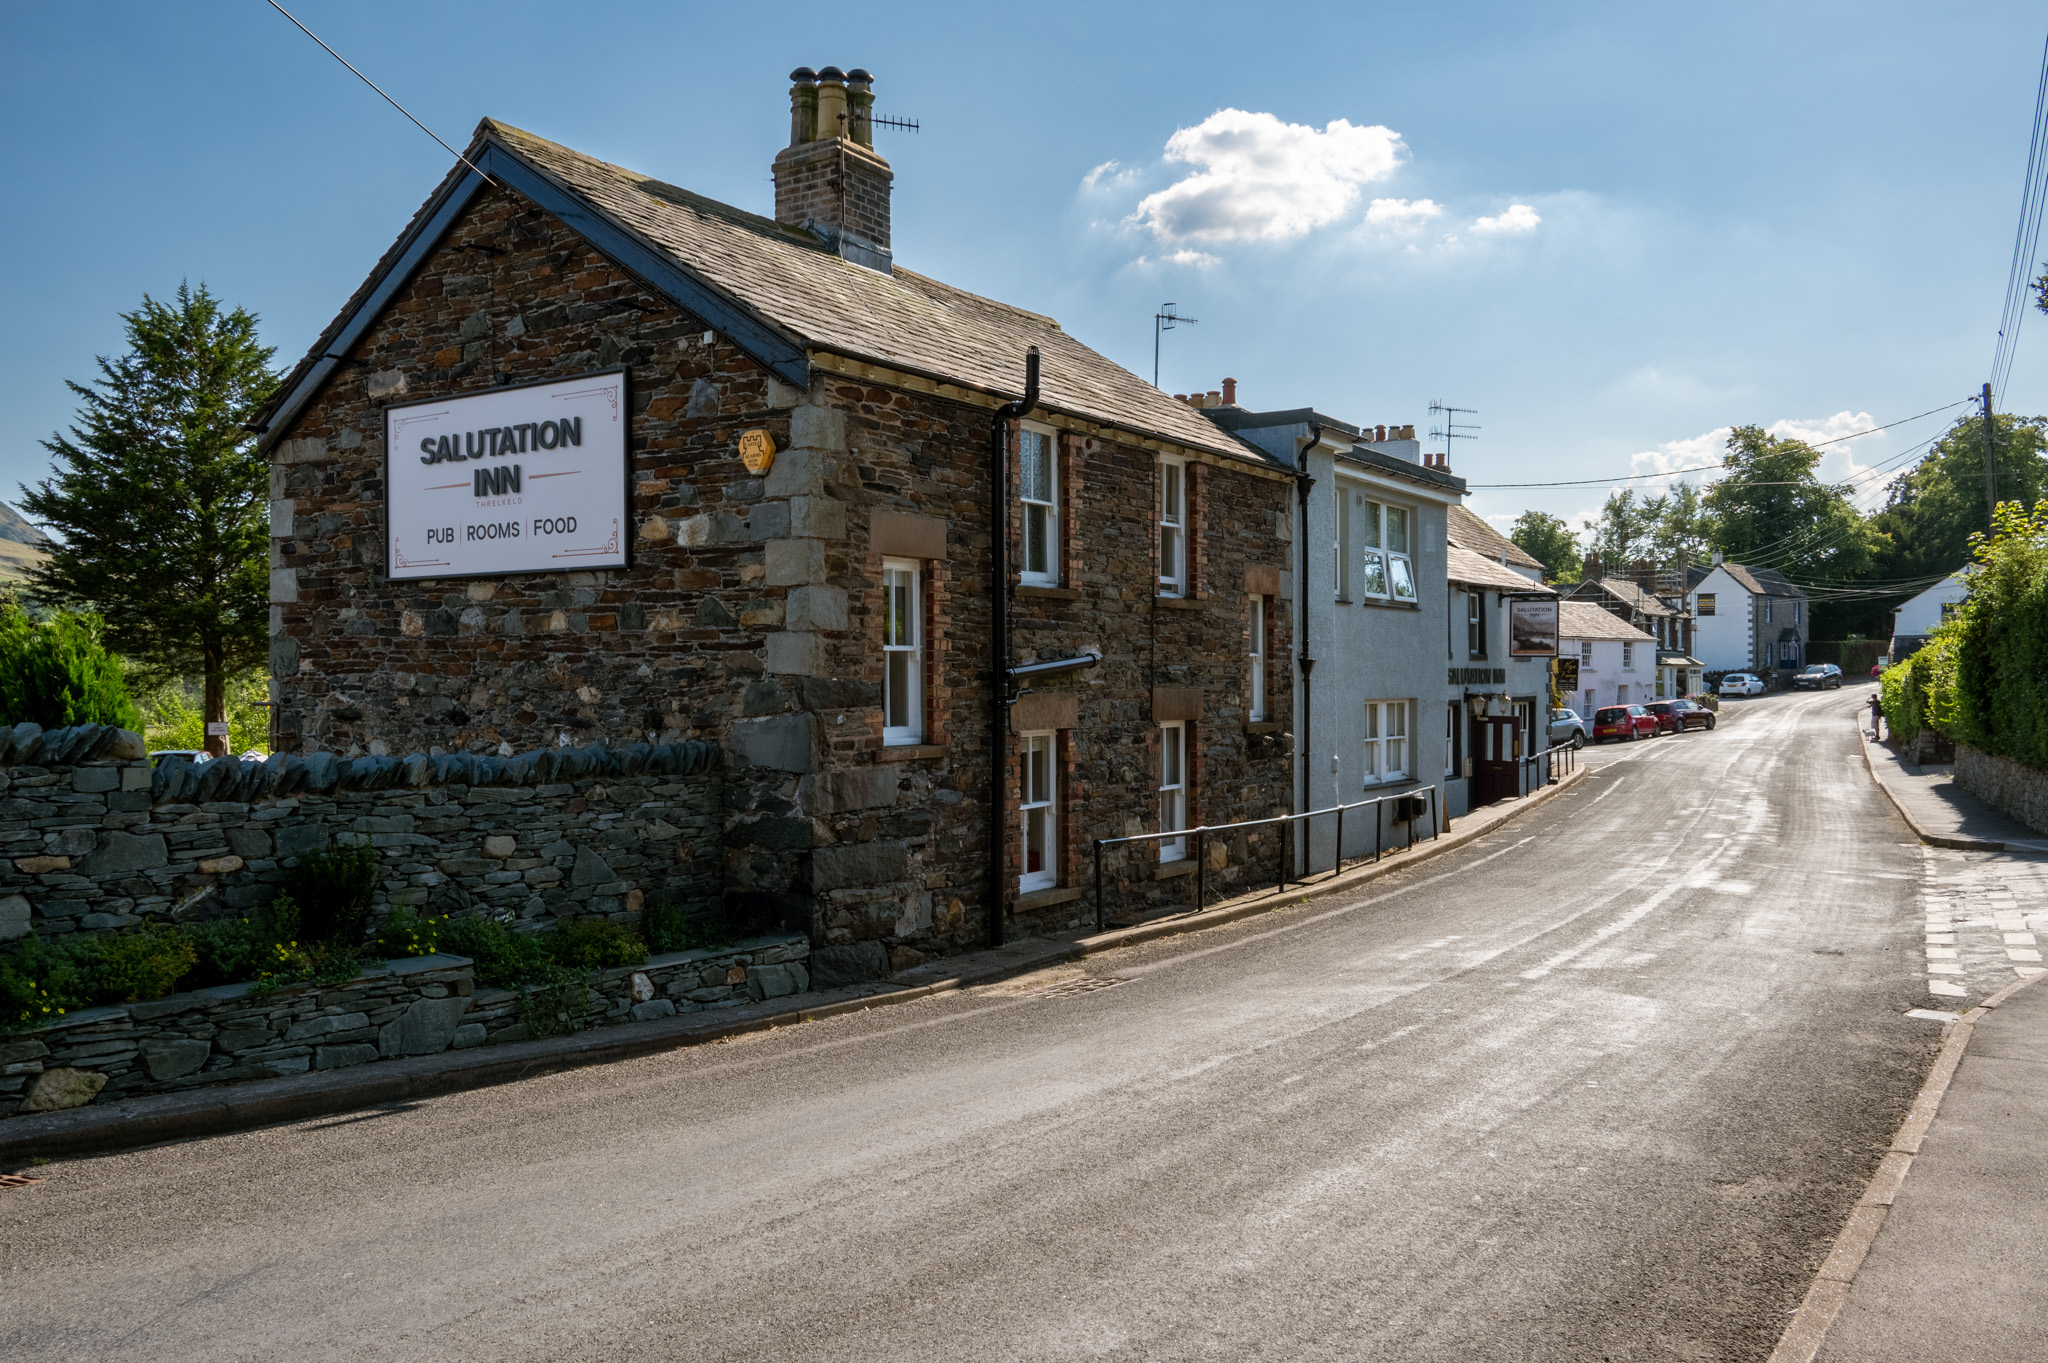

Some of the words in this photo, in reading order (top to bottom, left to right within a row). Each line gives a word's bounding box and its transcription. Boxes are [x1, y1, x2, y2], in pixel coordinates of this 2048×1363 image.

[420, 416, 582, 465] SALUTATION
[473, 464, 521, 497] INN
[475, 497, 523, 508] THRELKELD
[427, 527, 455, 544] PUB
[466, 521, 520, 541] ROOMS
[533, 516, 577, 536] FOOD
[1448, 668, 1491, 684] SALUTATION
[1493, 668, 1506, 684] INN
